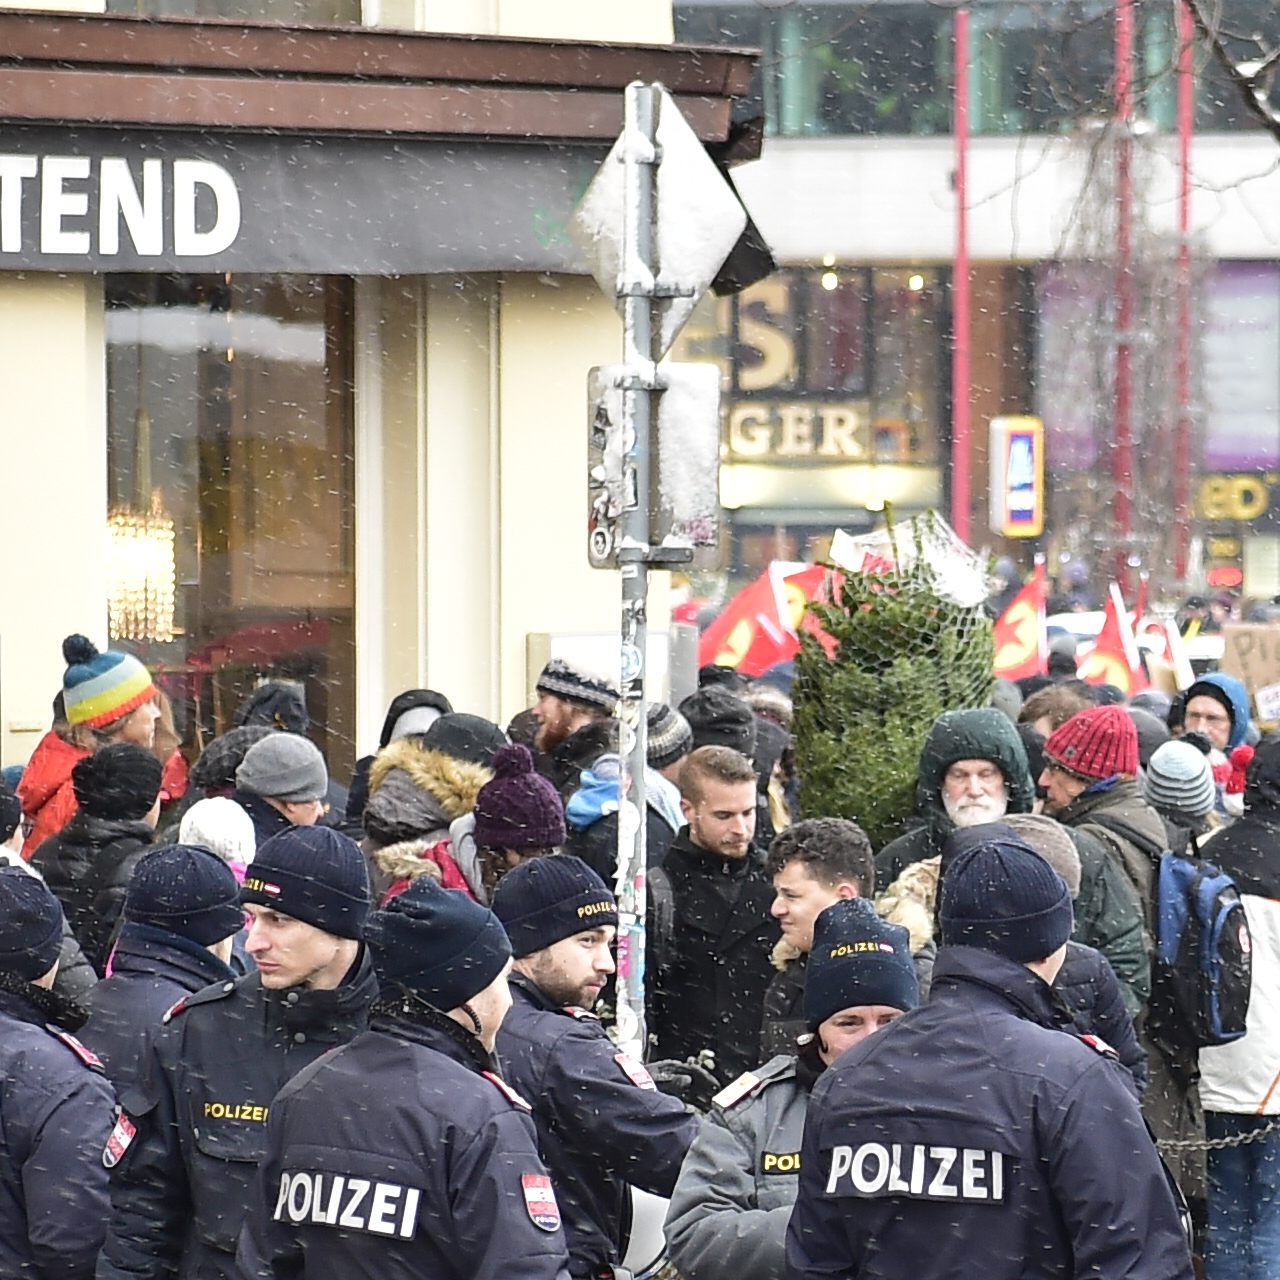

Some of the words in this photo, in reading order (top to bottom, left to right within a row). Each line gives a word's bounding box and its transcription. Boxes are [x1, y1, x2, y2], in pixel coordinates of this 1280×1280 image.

[722, 406, 864, 457] GER
[830, 942, 879, 959] POLIZEI
[204, 1102, 269, 1122] POLIZEI
[825, 1142, 1003, 1200] POLIZEI
[273, 1172, 420, 1238] POLIZEI
